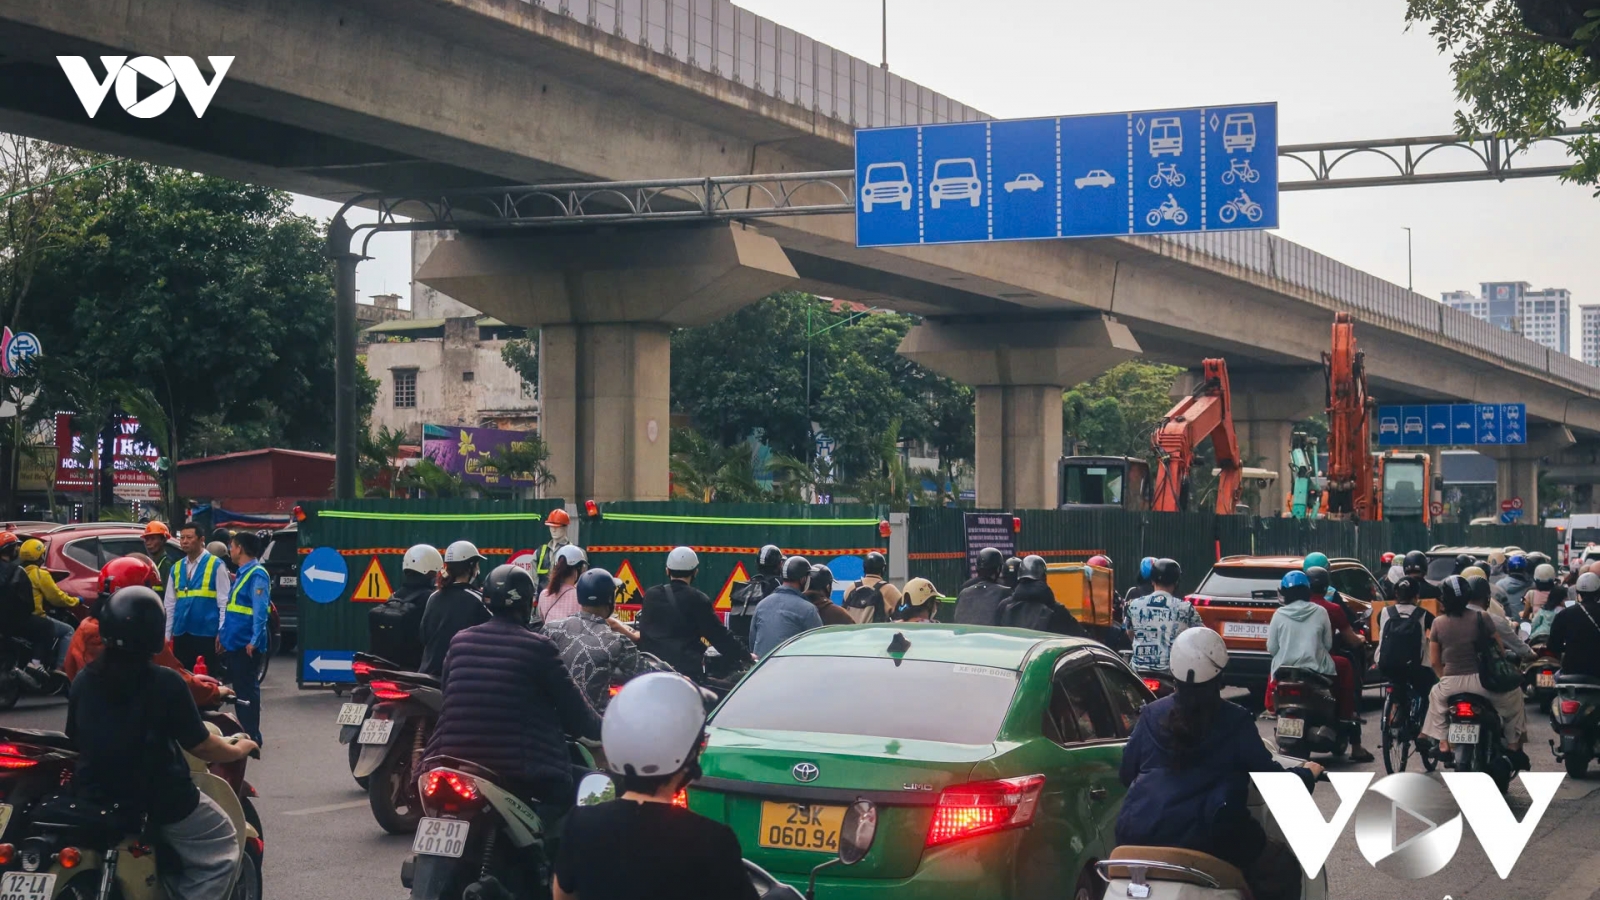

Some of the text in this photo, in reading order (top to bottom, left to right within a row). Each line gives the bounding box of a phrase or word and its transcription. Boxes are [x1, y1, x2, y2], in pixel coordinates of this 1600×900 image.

[1228, 624, 1268, 634] 30H-301.6
[360, 732, 388, 743] 037.70
[1451, 734, 1477, 742] 056.81
[425, 821, 461, 838] 29-D1
[769, 826, 837, 850] 060.94
[417, 836, 462, 855] 401.00
[10, 875, 47, 893] 12-LA
